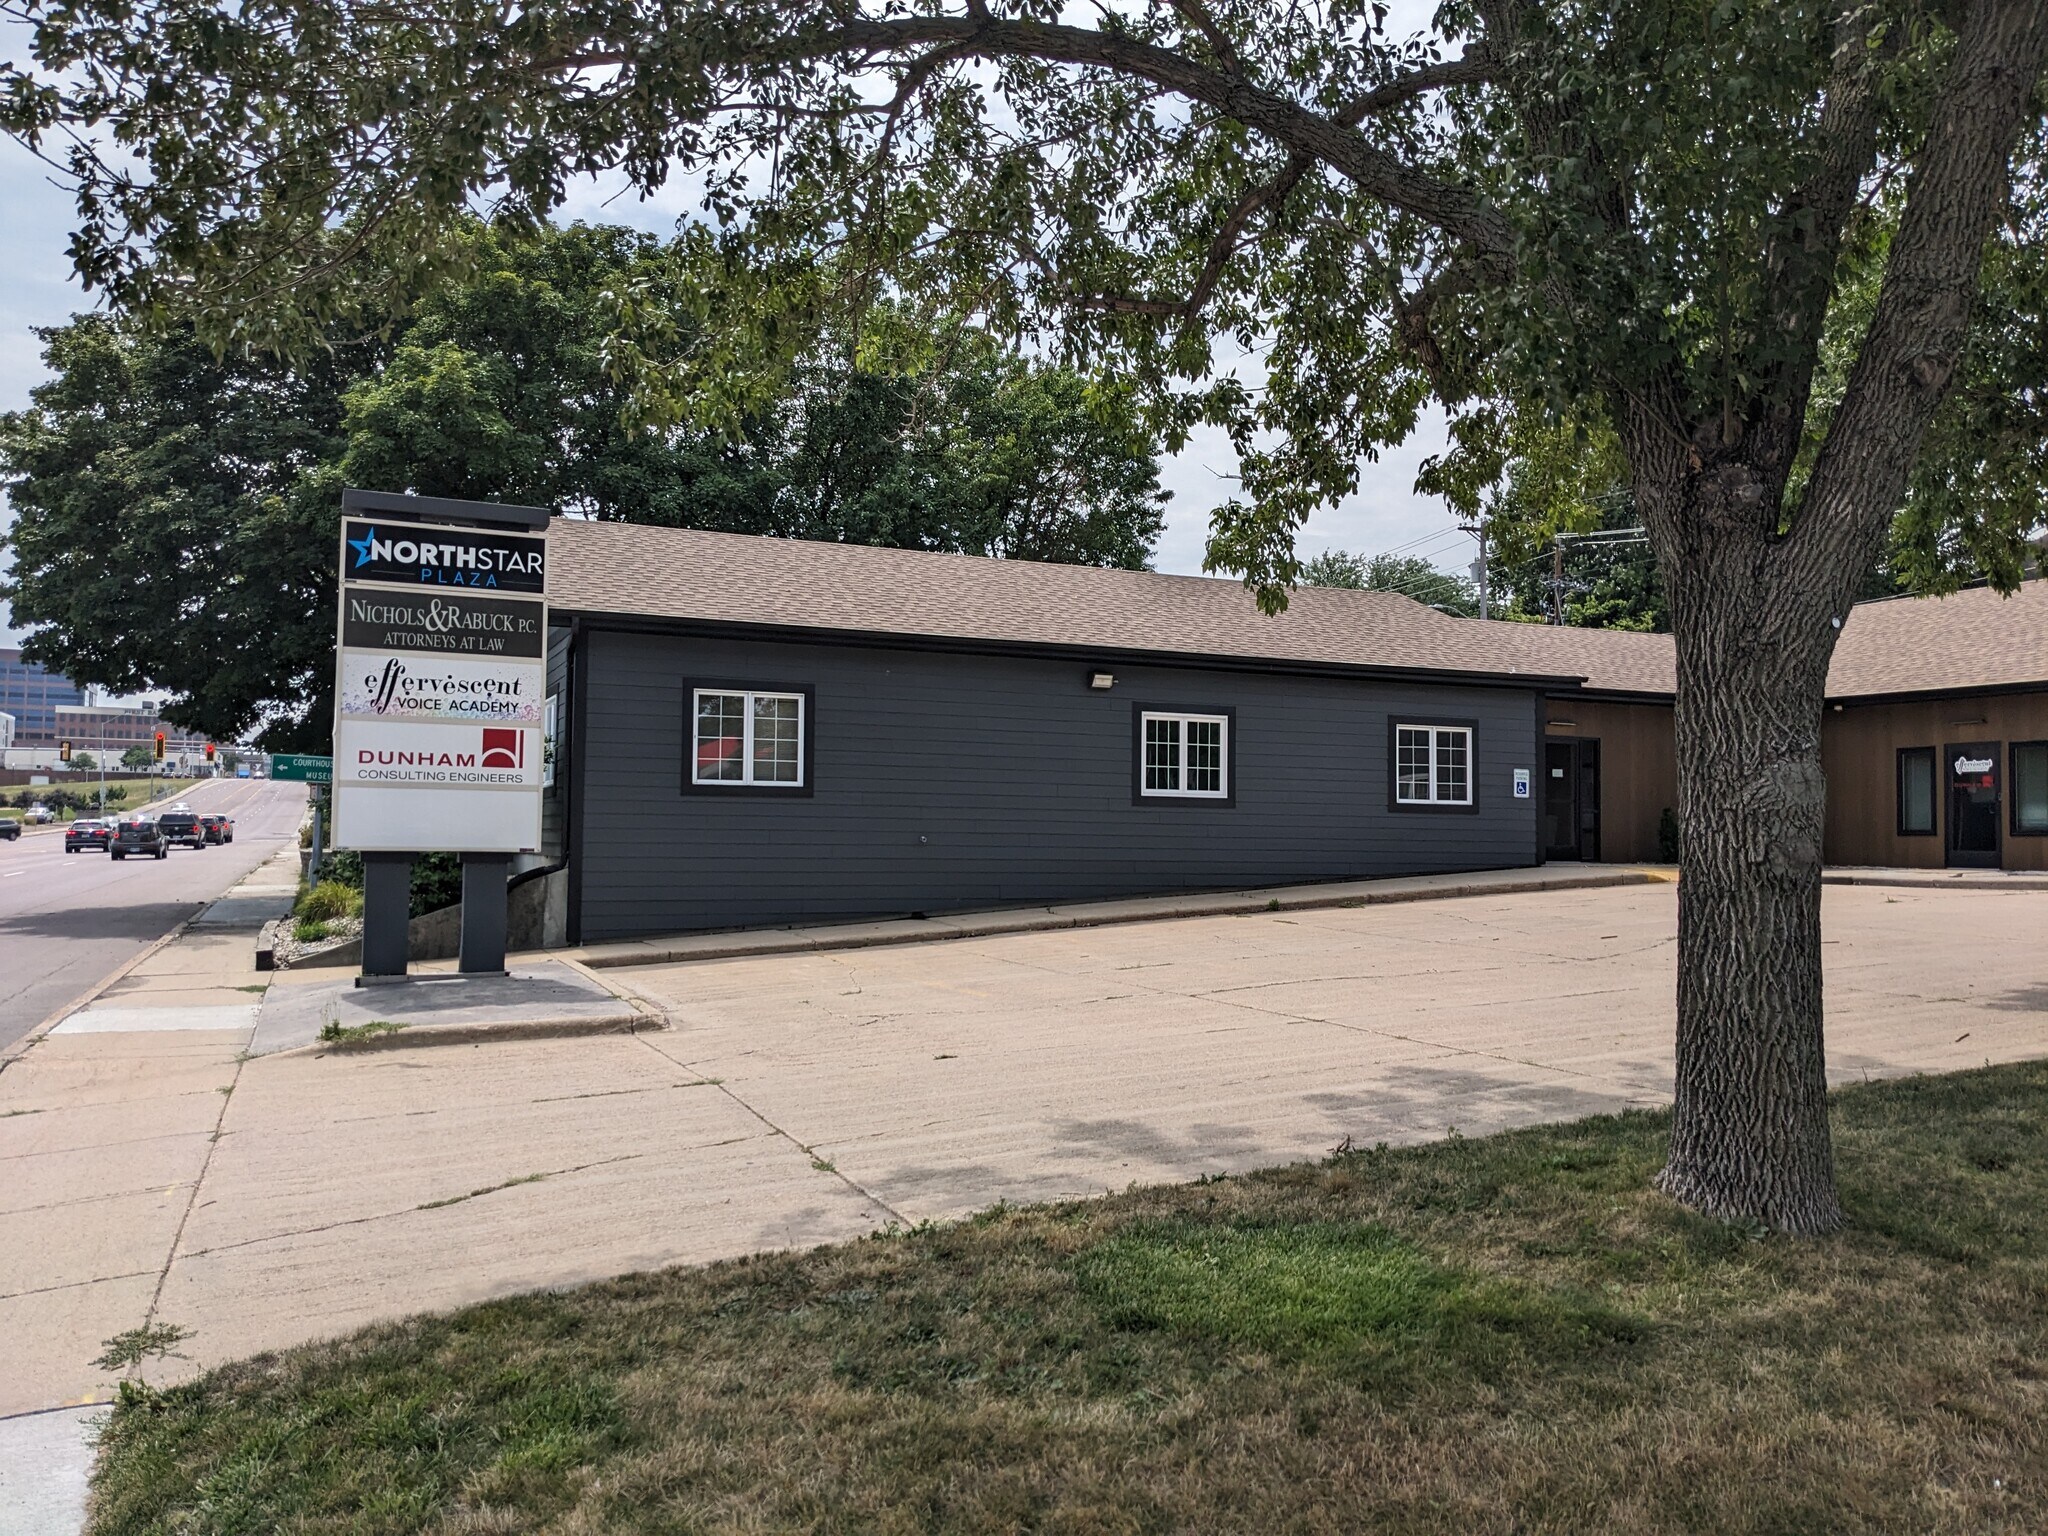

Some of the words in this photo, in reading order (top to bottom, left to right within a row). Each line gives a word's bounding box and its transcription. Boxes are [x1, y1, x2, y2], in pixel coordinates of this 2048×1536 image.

[371, 539, 543, 575] NORTHSTAR
[421, 568, 498, 587] PLAZA
[383, 631, 456, 649] ATTORNEYS
[459, 636, 476, 649] AT
[479, 637, 505, 650] LAW
[397, 697, 442, 710] VOICE
[449, 700, 520, 713] ACADEMY
[292, 758, 334, 768] COURTHOUS
[358, 750, 475, 767] DUNHAM
[358, 769, 446, 781] CONSULTING
[449, 772, 523, 783] ENGINEERS
